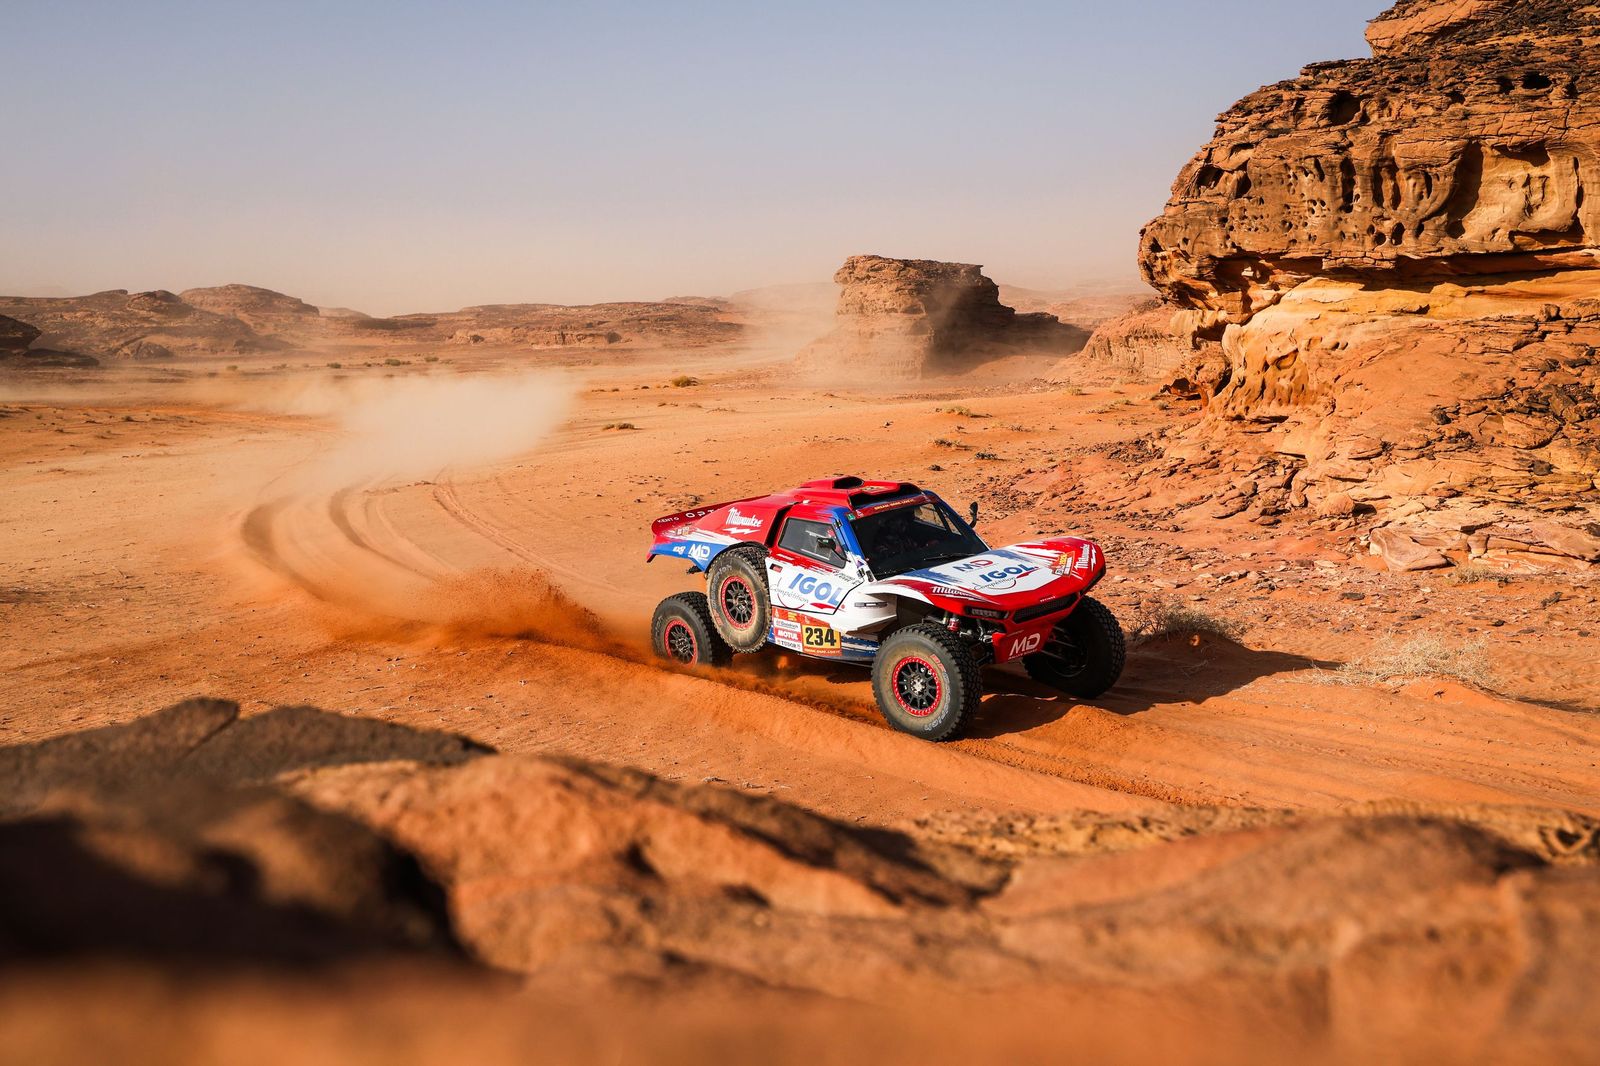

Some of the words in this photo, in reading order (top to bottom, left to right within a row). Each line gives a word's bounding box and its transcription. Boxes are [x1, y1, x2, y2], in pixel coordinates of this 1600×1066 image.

[725, 507, 764, 527] Milwaukee
[953, 559, 993, 572] MD
[979, 563, 1035, 582] IGOL
[788, 573, 843, 606] IGOL
[777, 629, 799, 640] MOTUL
[805, 627, 837, 646] 234
[1009, 633, 1041, 656] MD
